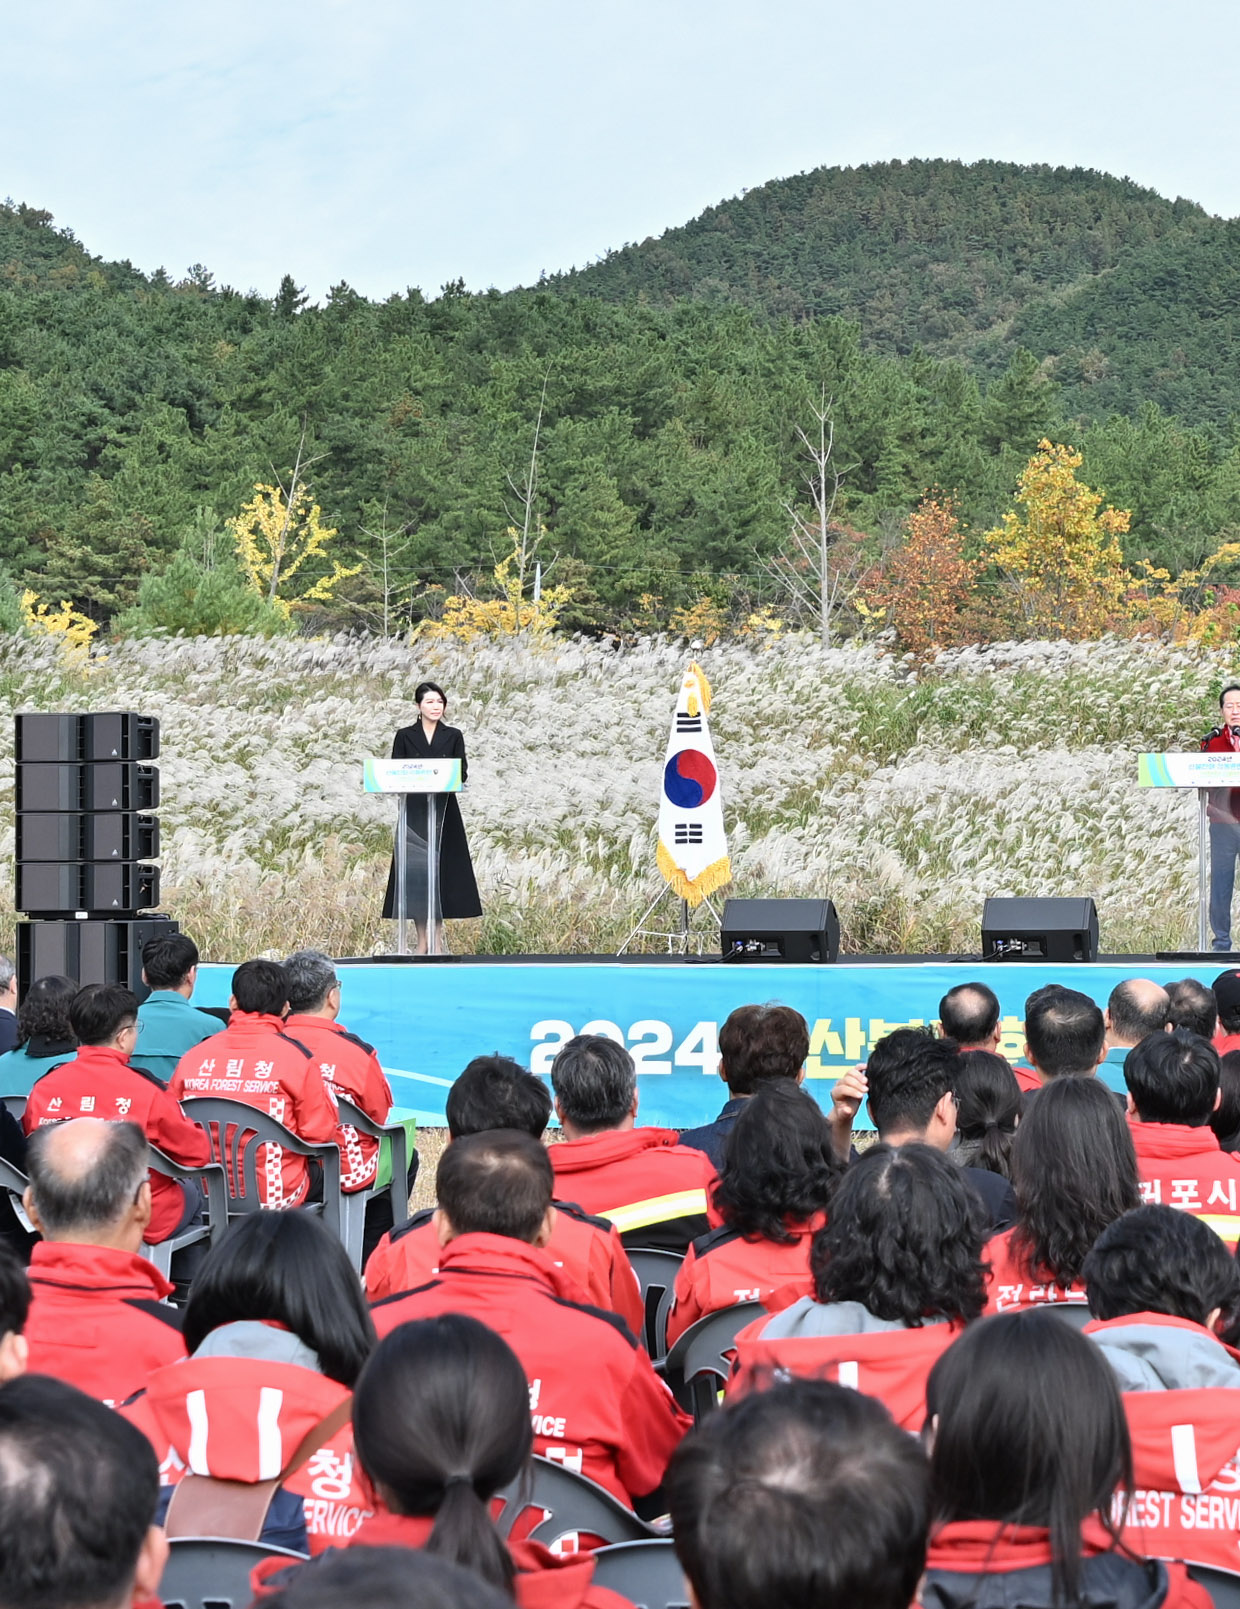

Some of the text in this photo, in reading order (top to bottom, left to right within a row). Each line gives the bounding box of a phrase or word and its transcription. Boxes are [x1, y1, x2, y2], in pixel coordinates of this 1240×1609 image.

[184, 1078, 280, 1094] KOREA FOREST SERVICE
